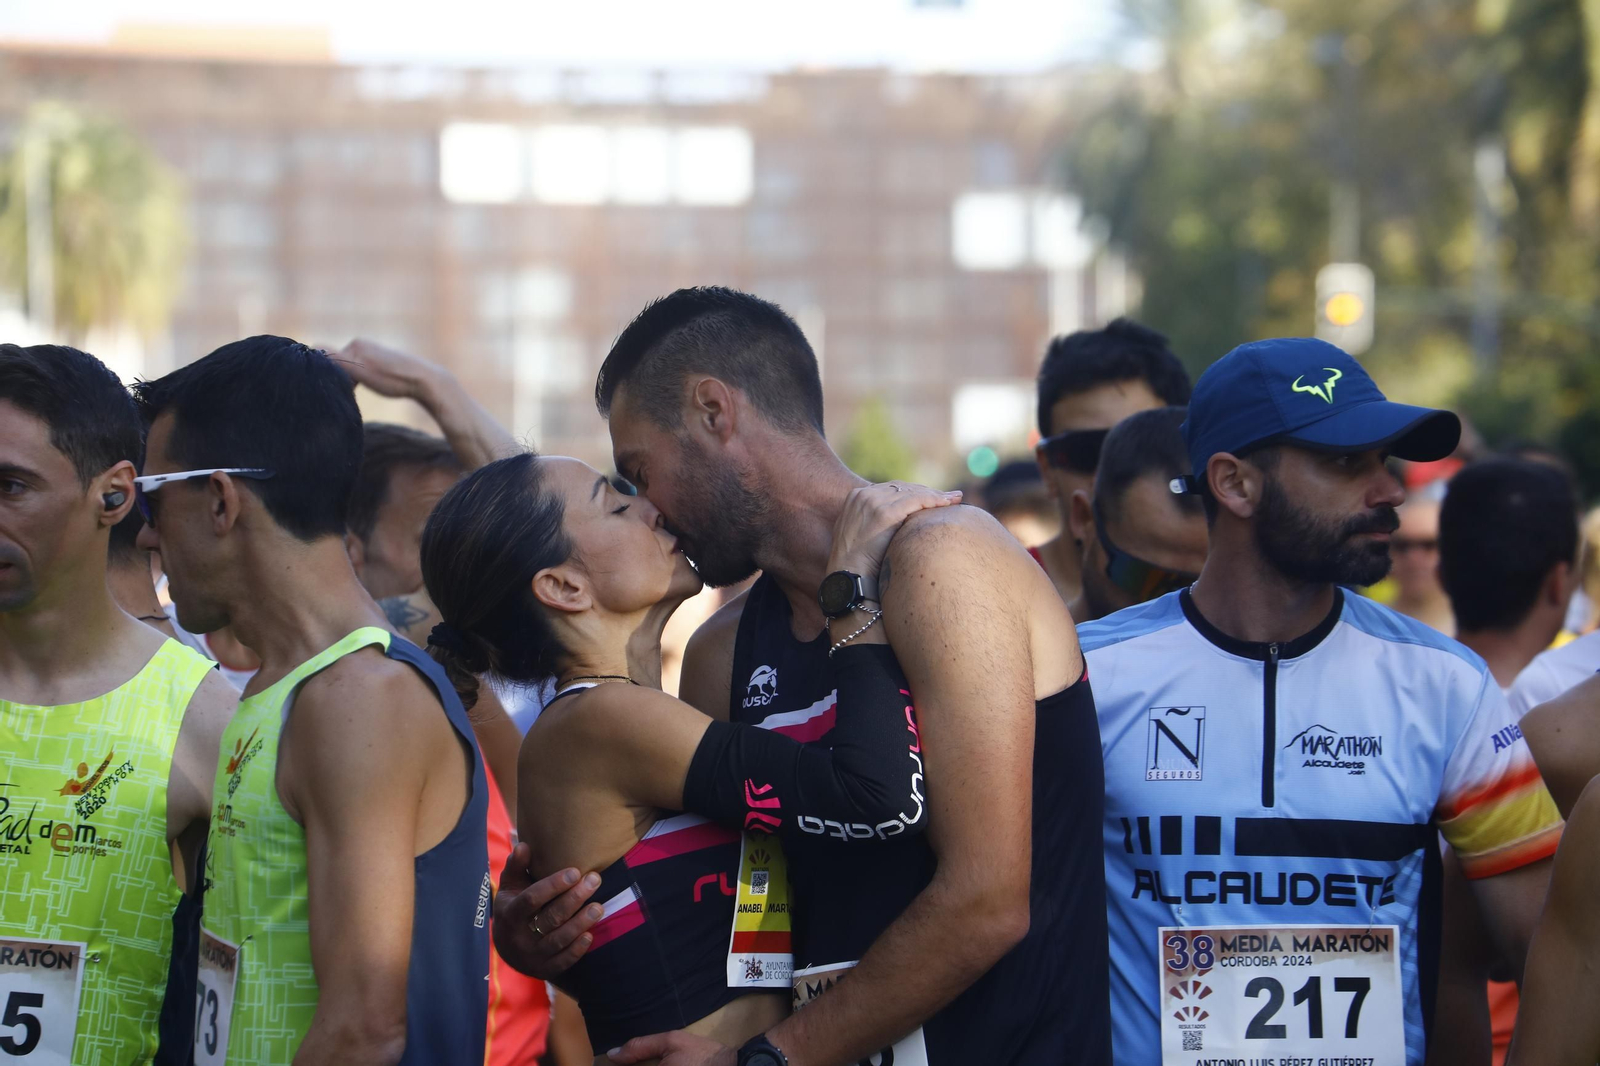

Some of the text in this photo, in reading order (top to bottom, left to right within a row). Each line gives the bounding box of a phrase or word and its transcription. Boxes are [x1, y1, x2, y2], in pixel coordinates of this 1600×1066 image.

[1149, 707, 1205, 769] Ñ
[1302, 735, 1382, 760] MARATHON
[1148, 771, 1200, 779] SEGUROS
[1302, 759, 1365, 769] Alcaudete
[74, 760, 131, 808] NEW YORK CITY
[76, 765, 135, 815] MARATHON
[80, 796, 107, 820] 2020
[1131, 870, 1397, 907] ALCAUDETE
[737, 903, 763, 913] ANABEL
[1166, 929, 1389, 970] 38 MEDIA MARATÓN
[1220, 953, 1313, 967] CÓRDOBA 2024
[765, 971, 773, 980] DE
[1244, 975, 1371, 1039] 217
[0, 991, 44, 1056] 5
